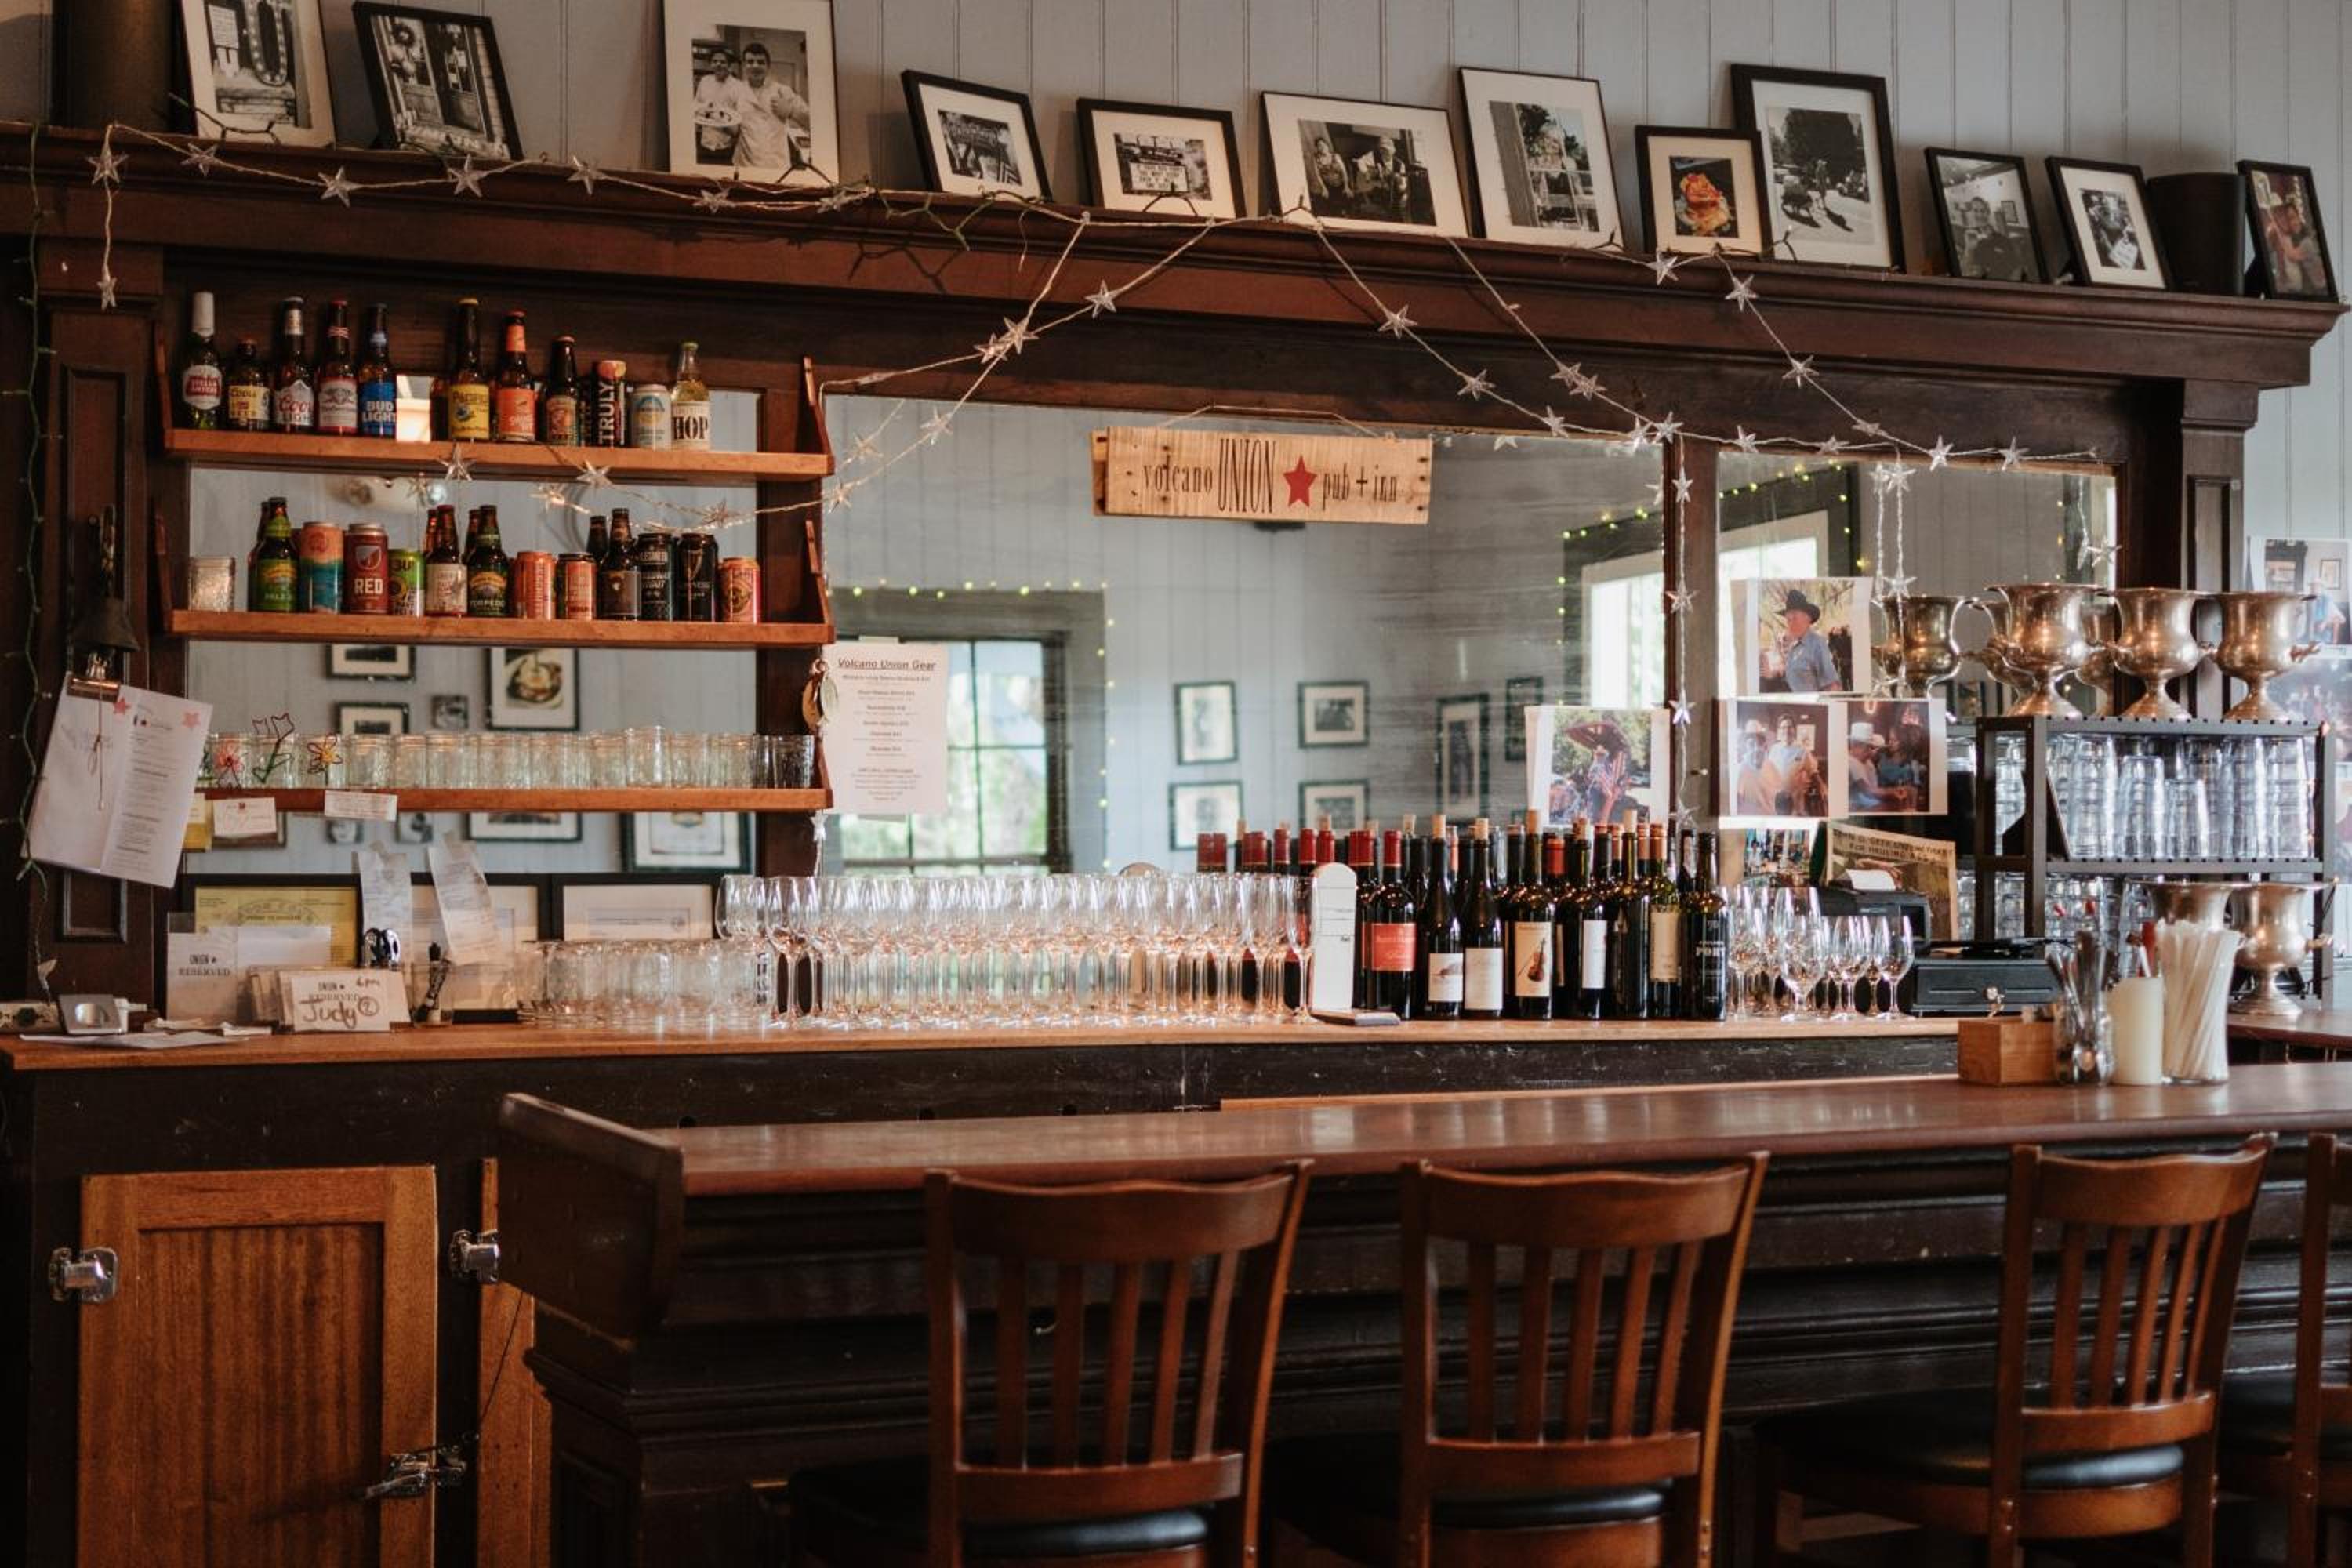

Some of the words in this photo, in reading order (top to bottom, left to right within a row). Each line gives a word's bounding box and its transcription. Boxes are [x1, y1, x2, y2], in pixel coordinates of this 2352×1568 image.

[366, 401, 394, 411] BUD
[599, 380, 614, 445] TRULY
[1143, 455, 1214, 493] volcano
[1217, 438, 1277, 514] UNION
[1322, 463, 1351, 511] pub
[1374, 465, 1398, 503] inn
[354, 578, 383, 594] RED
[838, 657, 878, 670] Volcano
[880, 659, 909, 671] Union
[912, 660, 936, 672] Gear
[178, 967, 231, 977] RESERVED
